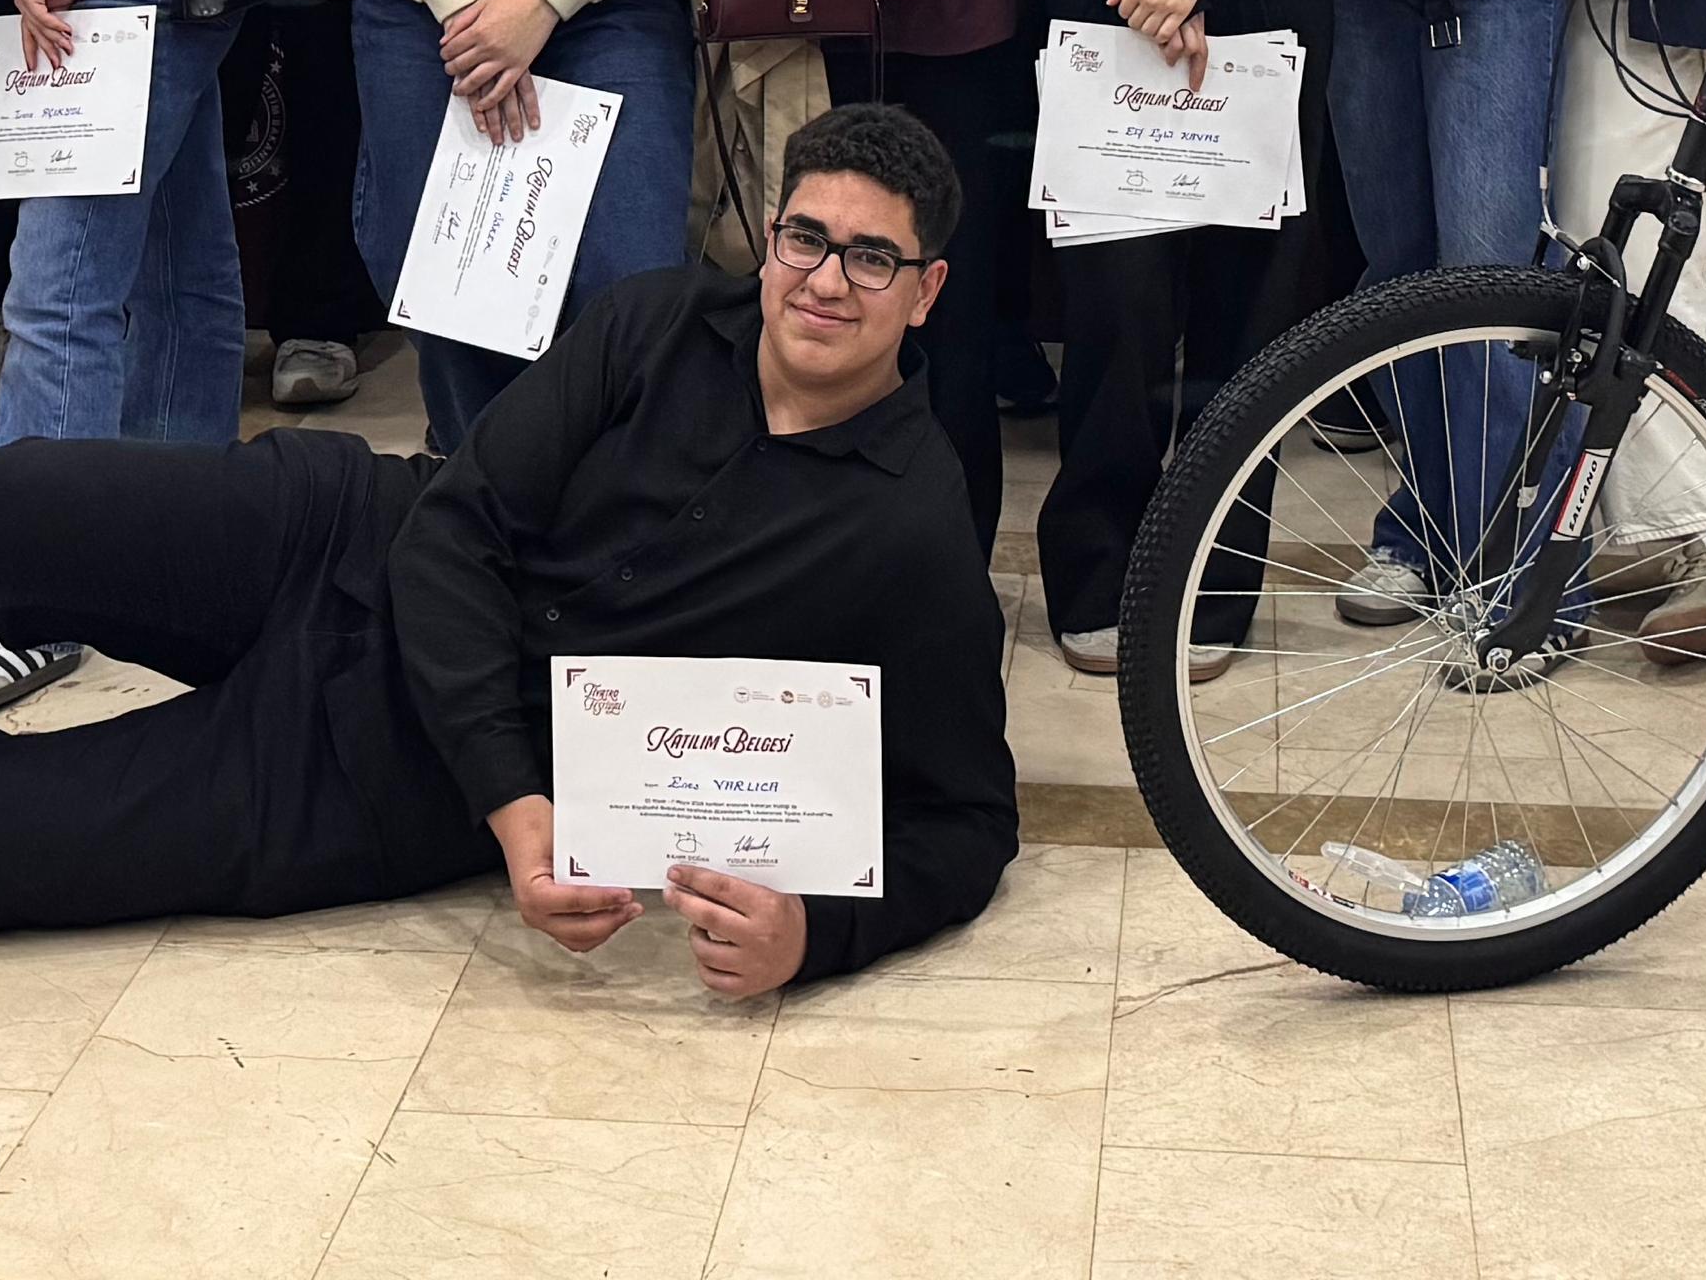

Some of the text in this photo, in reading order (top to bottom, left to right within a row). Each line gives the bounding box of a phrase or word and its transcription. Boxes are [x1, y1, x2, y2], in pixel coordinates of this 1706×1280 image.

[1113, 84, 1229, 112] KATILIM BELGESİ
[507, 156, 553, 278] KATILIM BELGESİ
[1569, 460, 1598, 532] SALCANO
[646, 726, 794, 758] KATILIM BELGESİ
